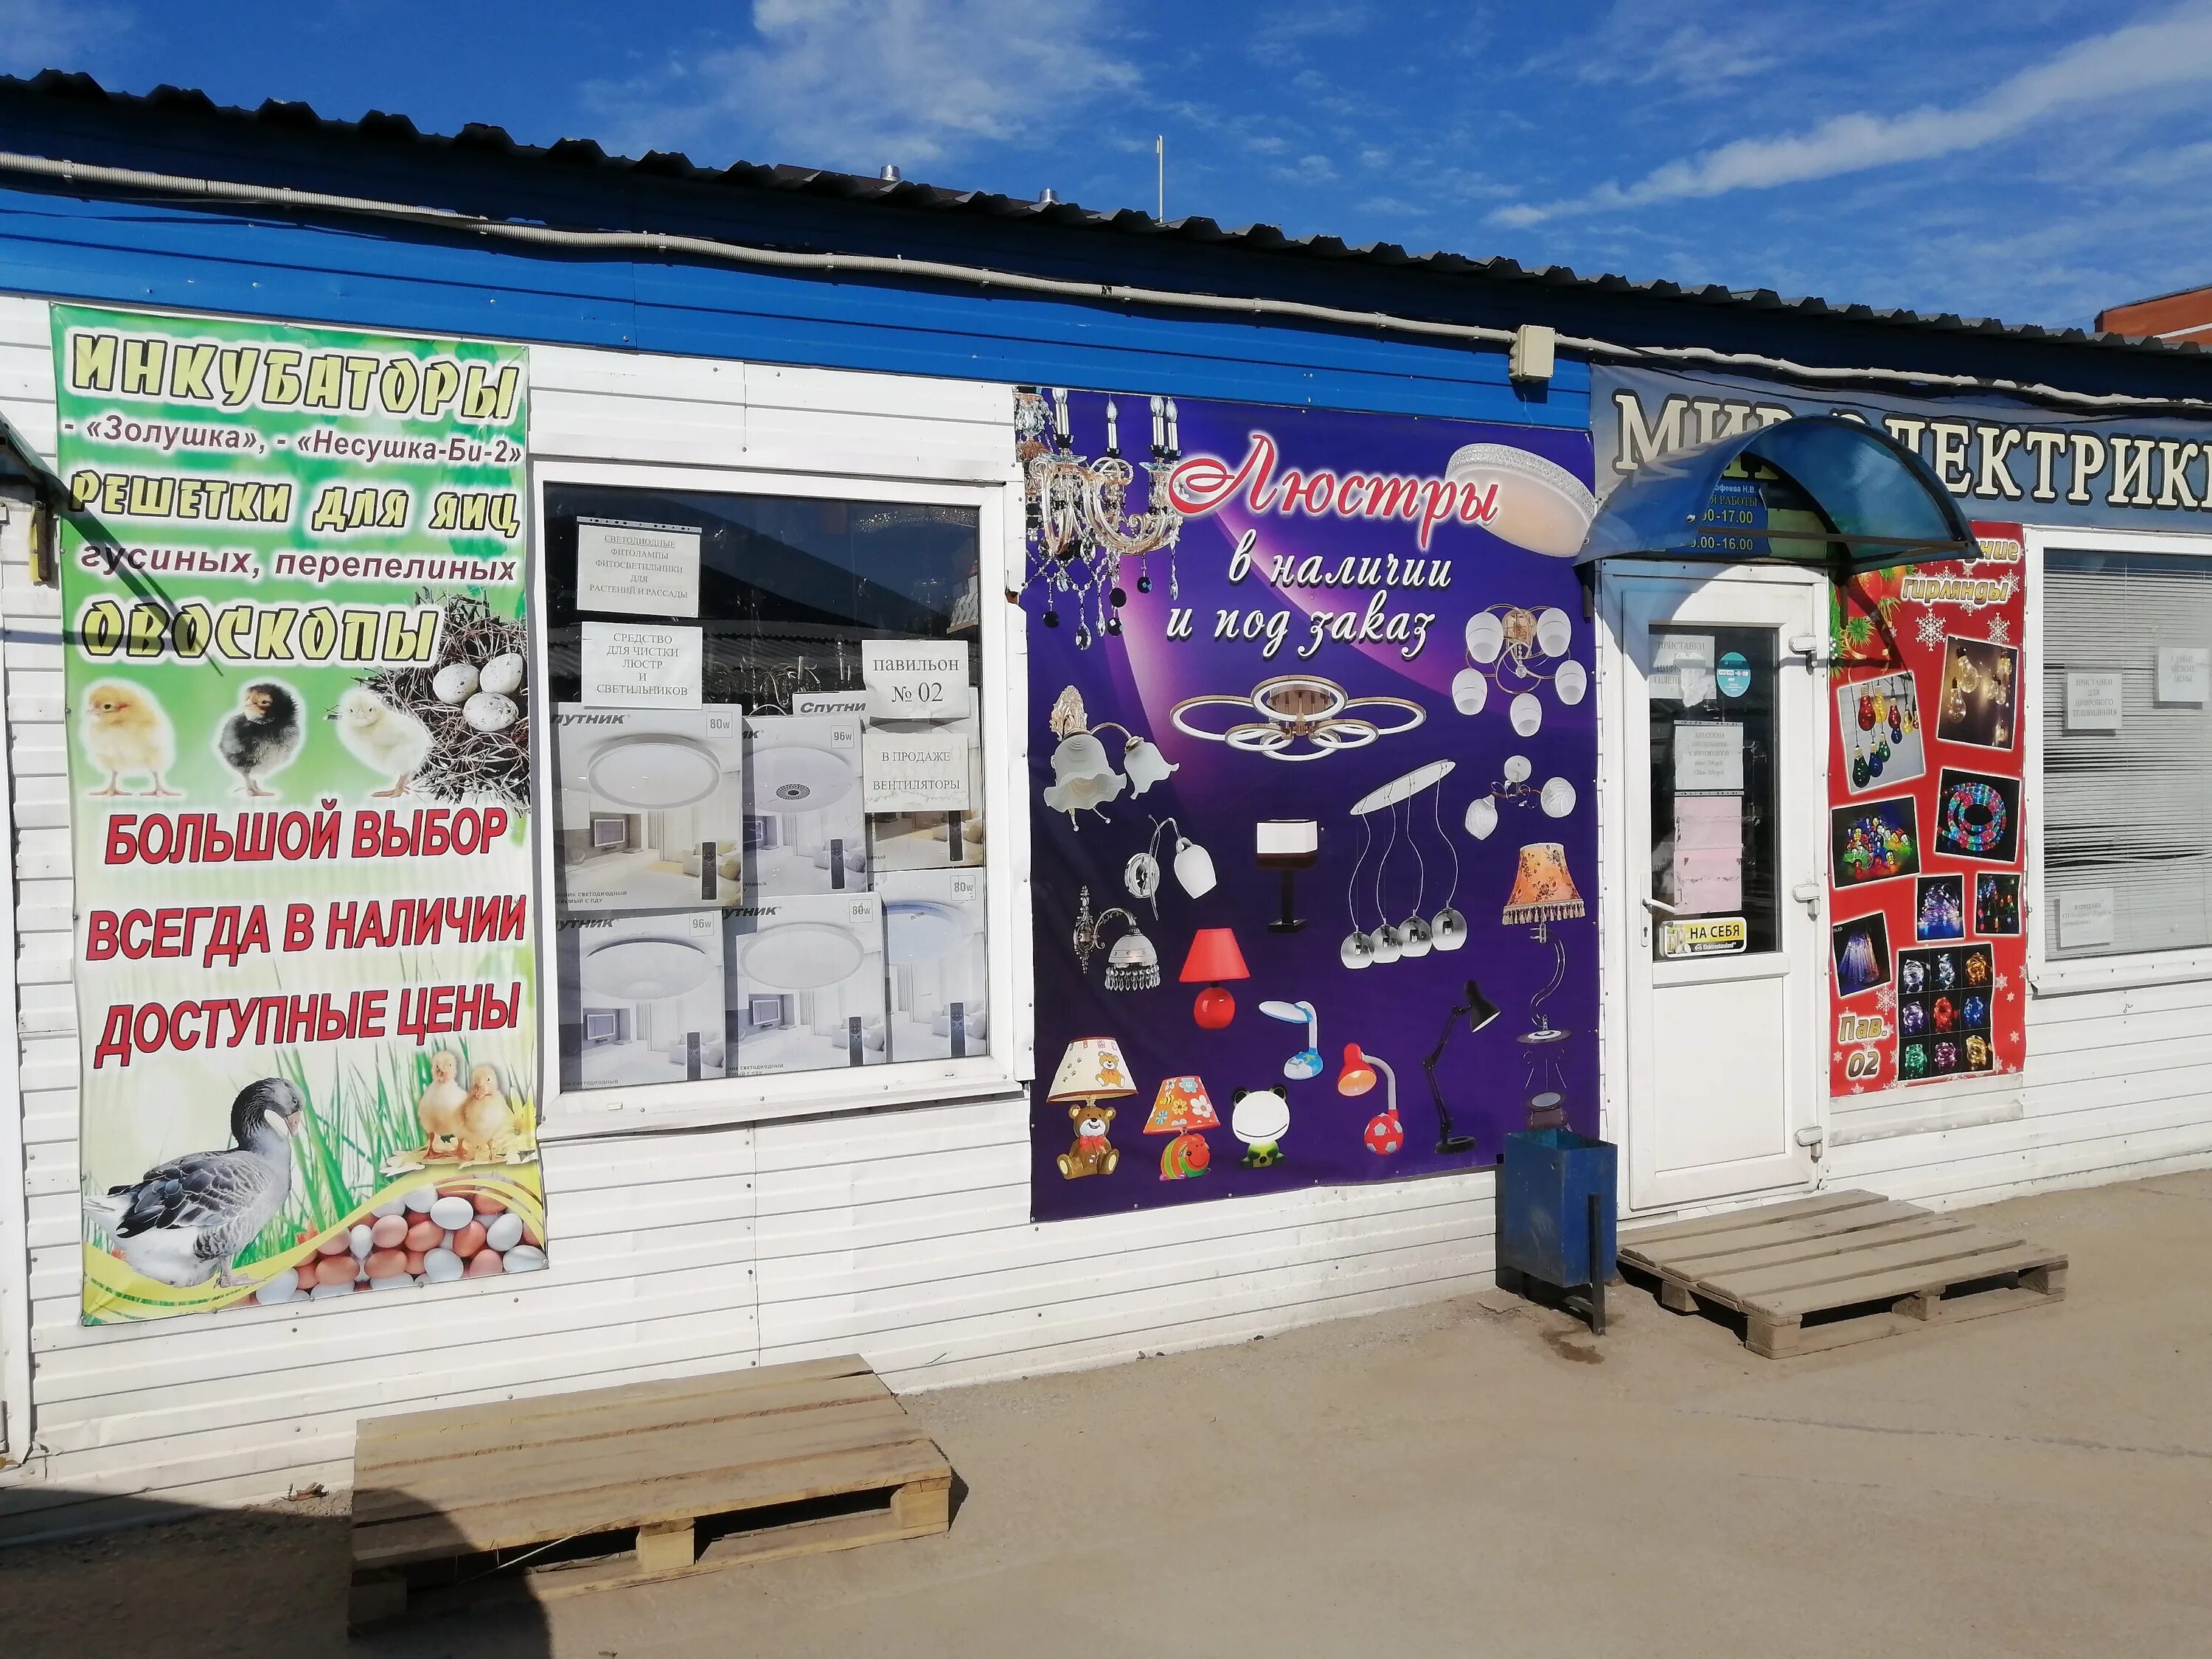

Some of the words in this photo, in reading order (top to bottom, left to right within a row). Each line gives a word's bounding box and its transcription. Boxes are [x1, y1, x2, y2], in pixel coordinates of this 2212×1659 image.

[72, 333, 520, 419] ИНКУБАТОРЫ
[87, 414, 265, 453] «Золушка»,
[297, 434, 522, 463] «Несушка-Би-2»
[1832, 412, 2212, 507] ЛЕКТРИК
[1169, 434, 1498, 547] Люстры
[72, 470, 292, 522] РЕШЕТКИ
[311, 487, 410, 532] ДЛЯ
[430, 494, 521, 538] ЯИЦ
[1719, 495, 1758, 507] РАБОТЫ
[604, 535, 676, 548] СВЕТОДИОДНЫЕ
[80, 544, 261, 580] гусиных,
[275, 553, 515, 582] перепелиных
[611, 549, 669, 560] ФИТОЛАМПЫ
[1228, 529, 1257, 583] в
[1270, 554, 1452, 588] наличии
[595, 560, 684, 573] ФИТОСВЕТИЛЬНИКИ
[630, 574, 648, 582] ДЛЯ
[589, 584, 637, 594] РАСТЕНИЙ
[646, 588, 688, 599] РАССАДЫ
[1902, 580, 2008, 605] гирлянды
[81, 600, 439, 661] ОВОСКОПЫ
[1167, 609, 1192, 638] и
[1214, 604, 1290, 658] под
[1298, 590, 1435, 658] заказ
[613, 633, 672, 644] СРЕДСТВО
[1658, 641, 1705, 650] ПРИСТАВКИ
[606, 646, 630, 655] ДЛЯ
[633, 647, 679, 657] ЧИСТКИ
[622, 659, 663, 669] ЛЮСТР
[873, 659, 959, 671] павильон
[639, 672, 647, 681] И
[597, 684, 688, 696] СВЕТИЛЬНИКОВ
[891, 686, 912, 703] №
[918, 682, 944, 702] 02
[882, 751, 889, 762] В
[893, 751, 950, 763] ПРОДАЖЕ
[873, 780, 959, 790] ВЕНТИЛЯТОРЫ
[105, 799, 341, 864] БОЛЬШОЙ
[351, 807, 508, 859] ВЫБОР
[86, 905, 271, 968] ВСЕГДА
[282, 904, 314, 952] В
[326, 894, 526, 950] НАЛИЧИИ
[1690, 927, 1706, 939] НА
[1711, 925, 1740, 938] СЕБЯ
[93, 990, 388, 1068] ДОСТУПНЫЕ
[397, 982, 521, 1046] ЦЕНЫ
[1840, 1016, 1888, 1041] Пав.
[1848, 1051, 1879, 1078] 02
